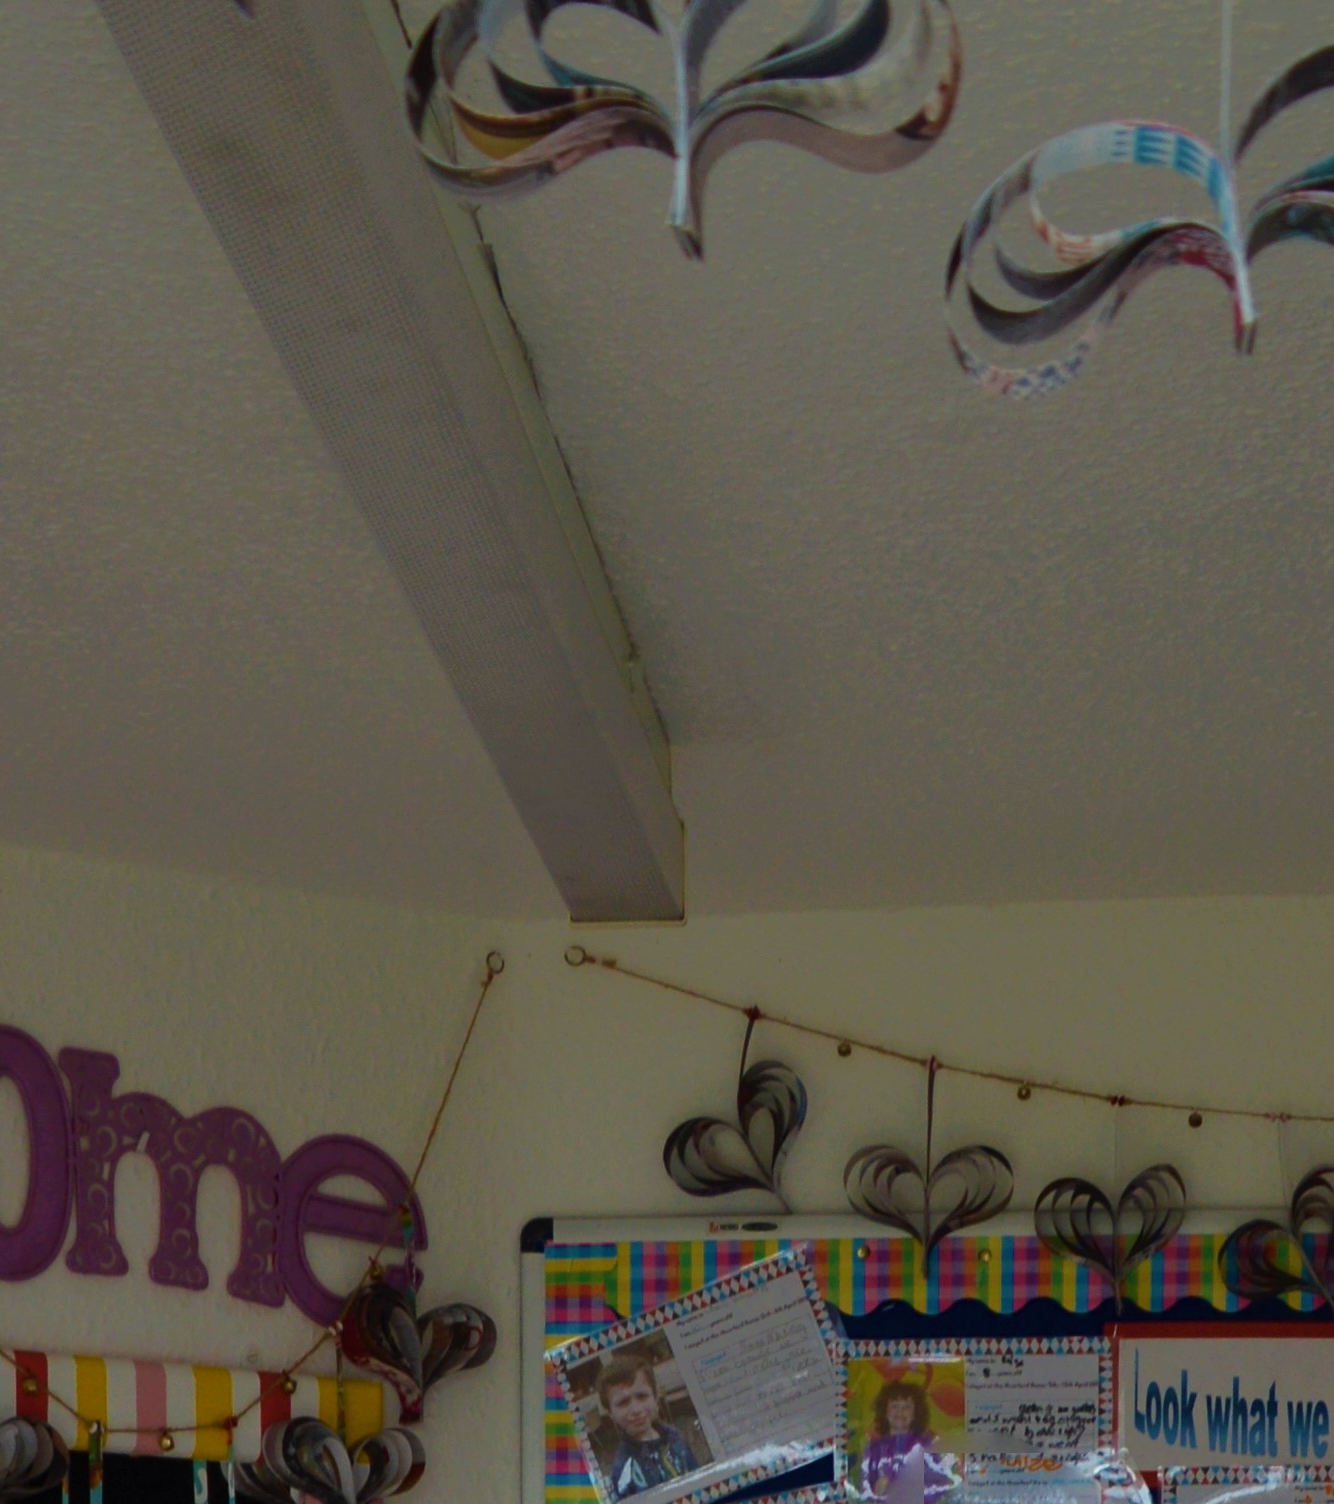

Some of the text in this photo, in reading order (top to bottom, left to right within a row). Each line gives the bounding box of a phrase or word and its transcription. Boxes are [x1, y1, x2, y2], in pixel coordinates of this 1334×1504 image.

[1134, 1347, 1197, 1450] Look
[1206, 1377, 1278, 1457] what
[1287, 1400, 1330, 1459] we
